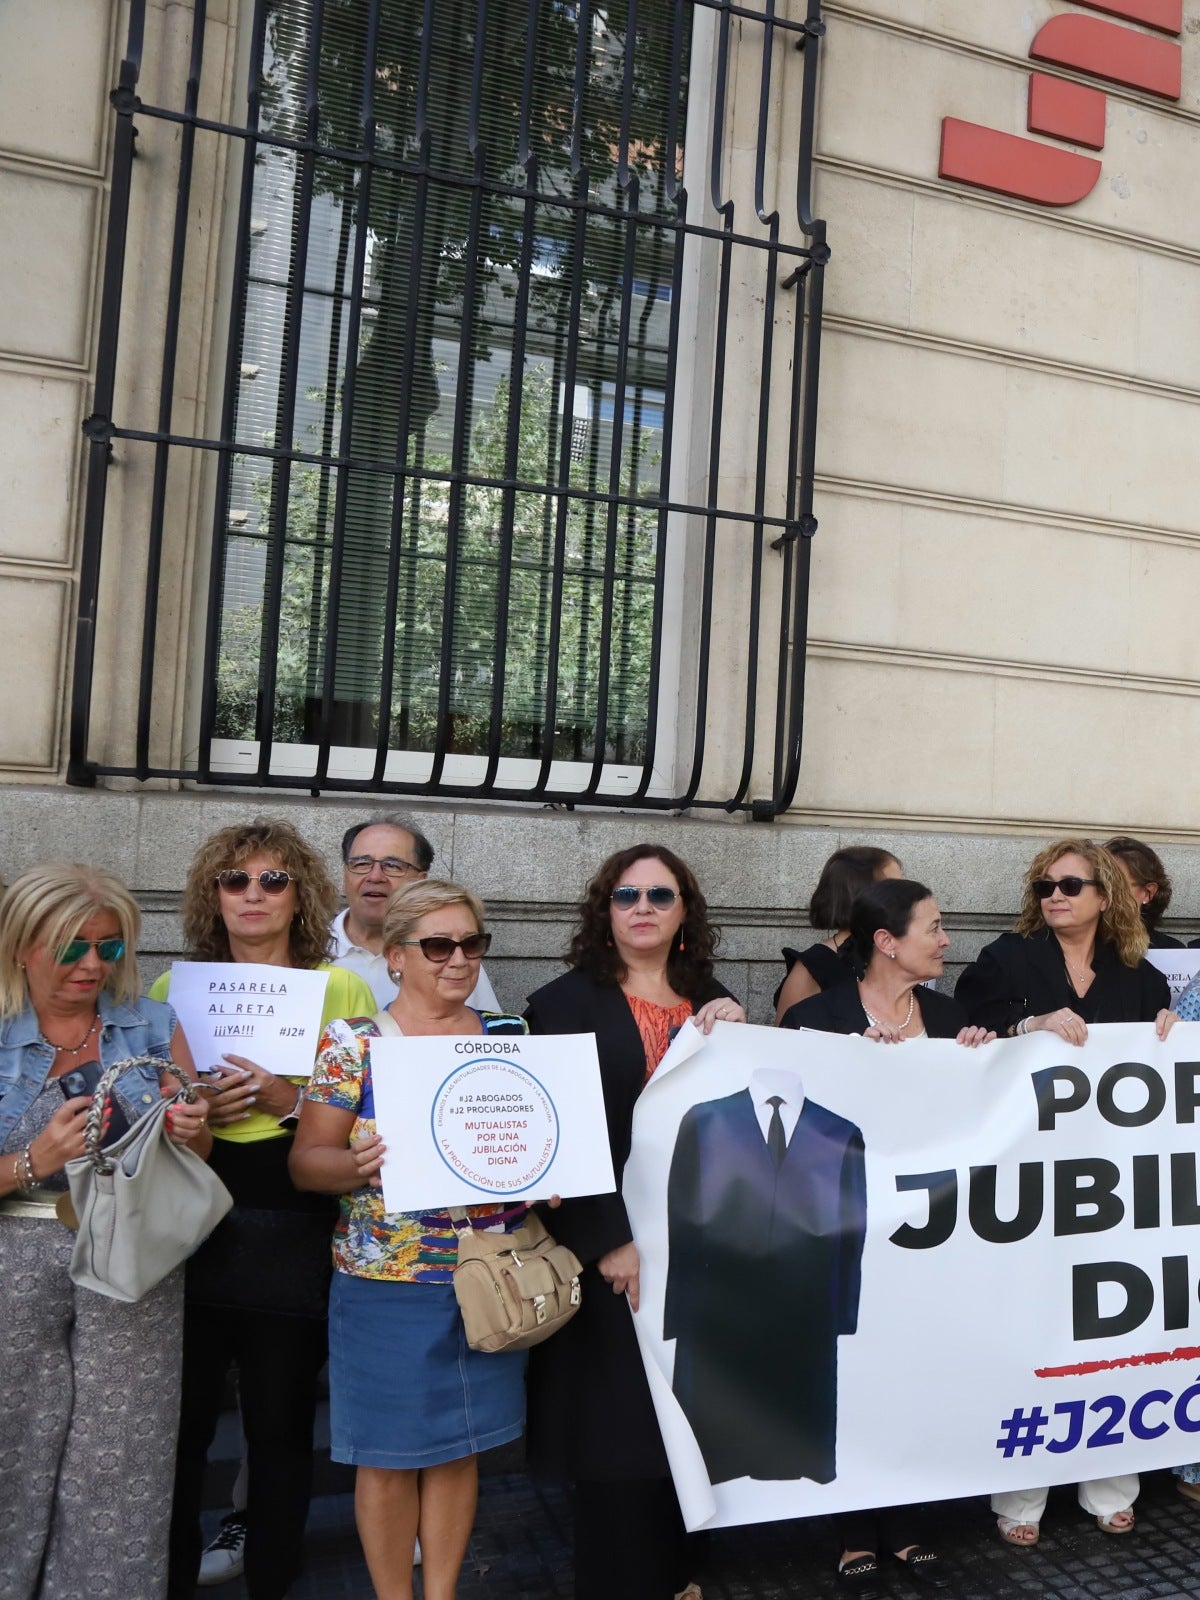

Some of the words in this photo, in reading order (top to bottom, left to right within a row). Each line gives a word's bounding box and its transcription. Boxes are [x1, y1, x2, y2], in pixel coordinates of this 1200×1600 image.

[208, 982, 288, 994] PASARELA
[208, 1003, 225, 1013] AL
[236, 1003, 275, 1014] RETA
[214, 1025, 255, 1037] ¡¡¡YA!!!
[279, 1026, 305, 1037] #J2#
[454, 1041, 521, 1054] CÓRDOBA
[476, 1094, 523, 1102] ABOGADOS
[467, 1105, 534, 1114] PROCURADORES
[464, 1120, 528, 1130] MUTUALISTAS
[477, 1133, 496, 1141] POR
[499, 1132, 519, 1141] UNA
[472, 1143, 527, 1154] JUBILACIÓN
[441, 1138, 449, 1150] LA
[448, 1150, 493, 1187] PROTECCIÓN
[508, 1178, 522, 1188] SUS
[522, 1137, 553, 1183] MUTUALISTAS
[488, 1157, 518, 1165] DIGNA
